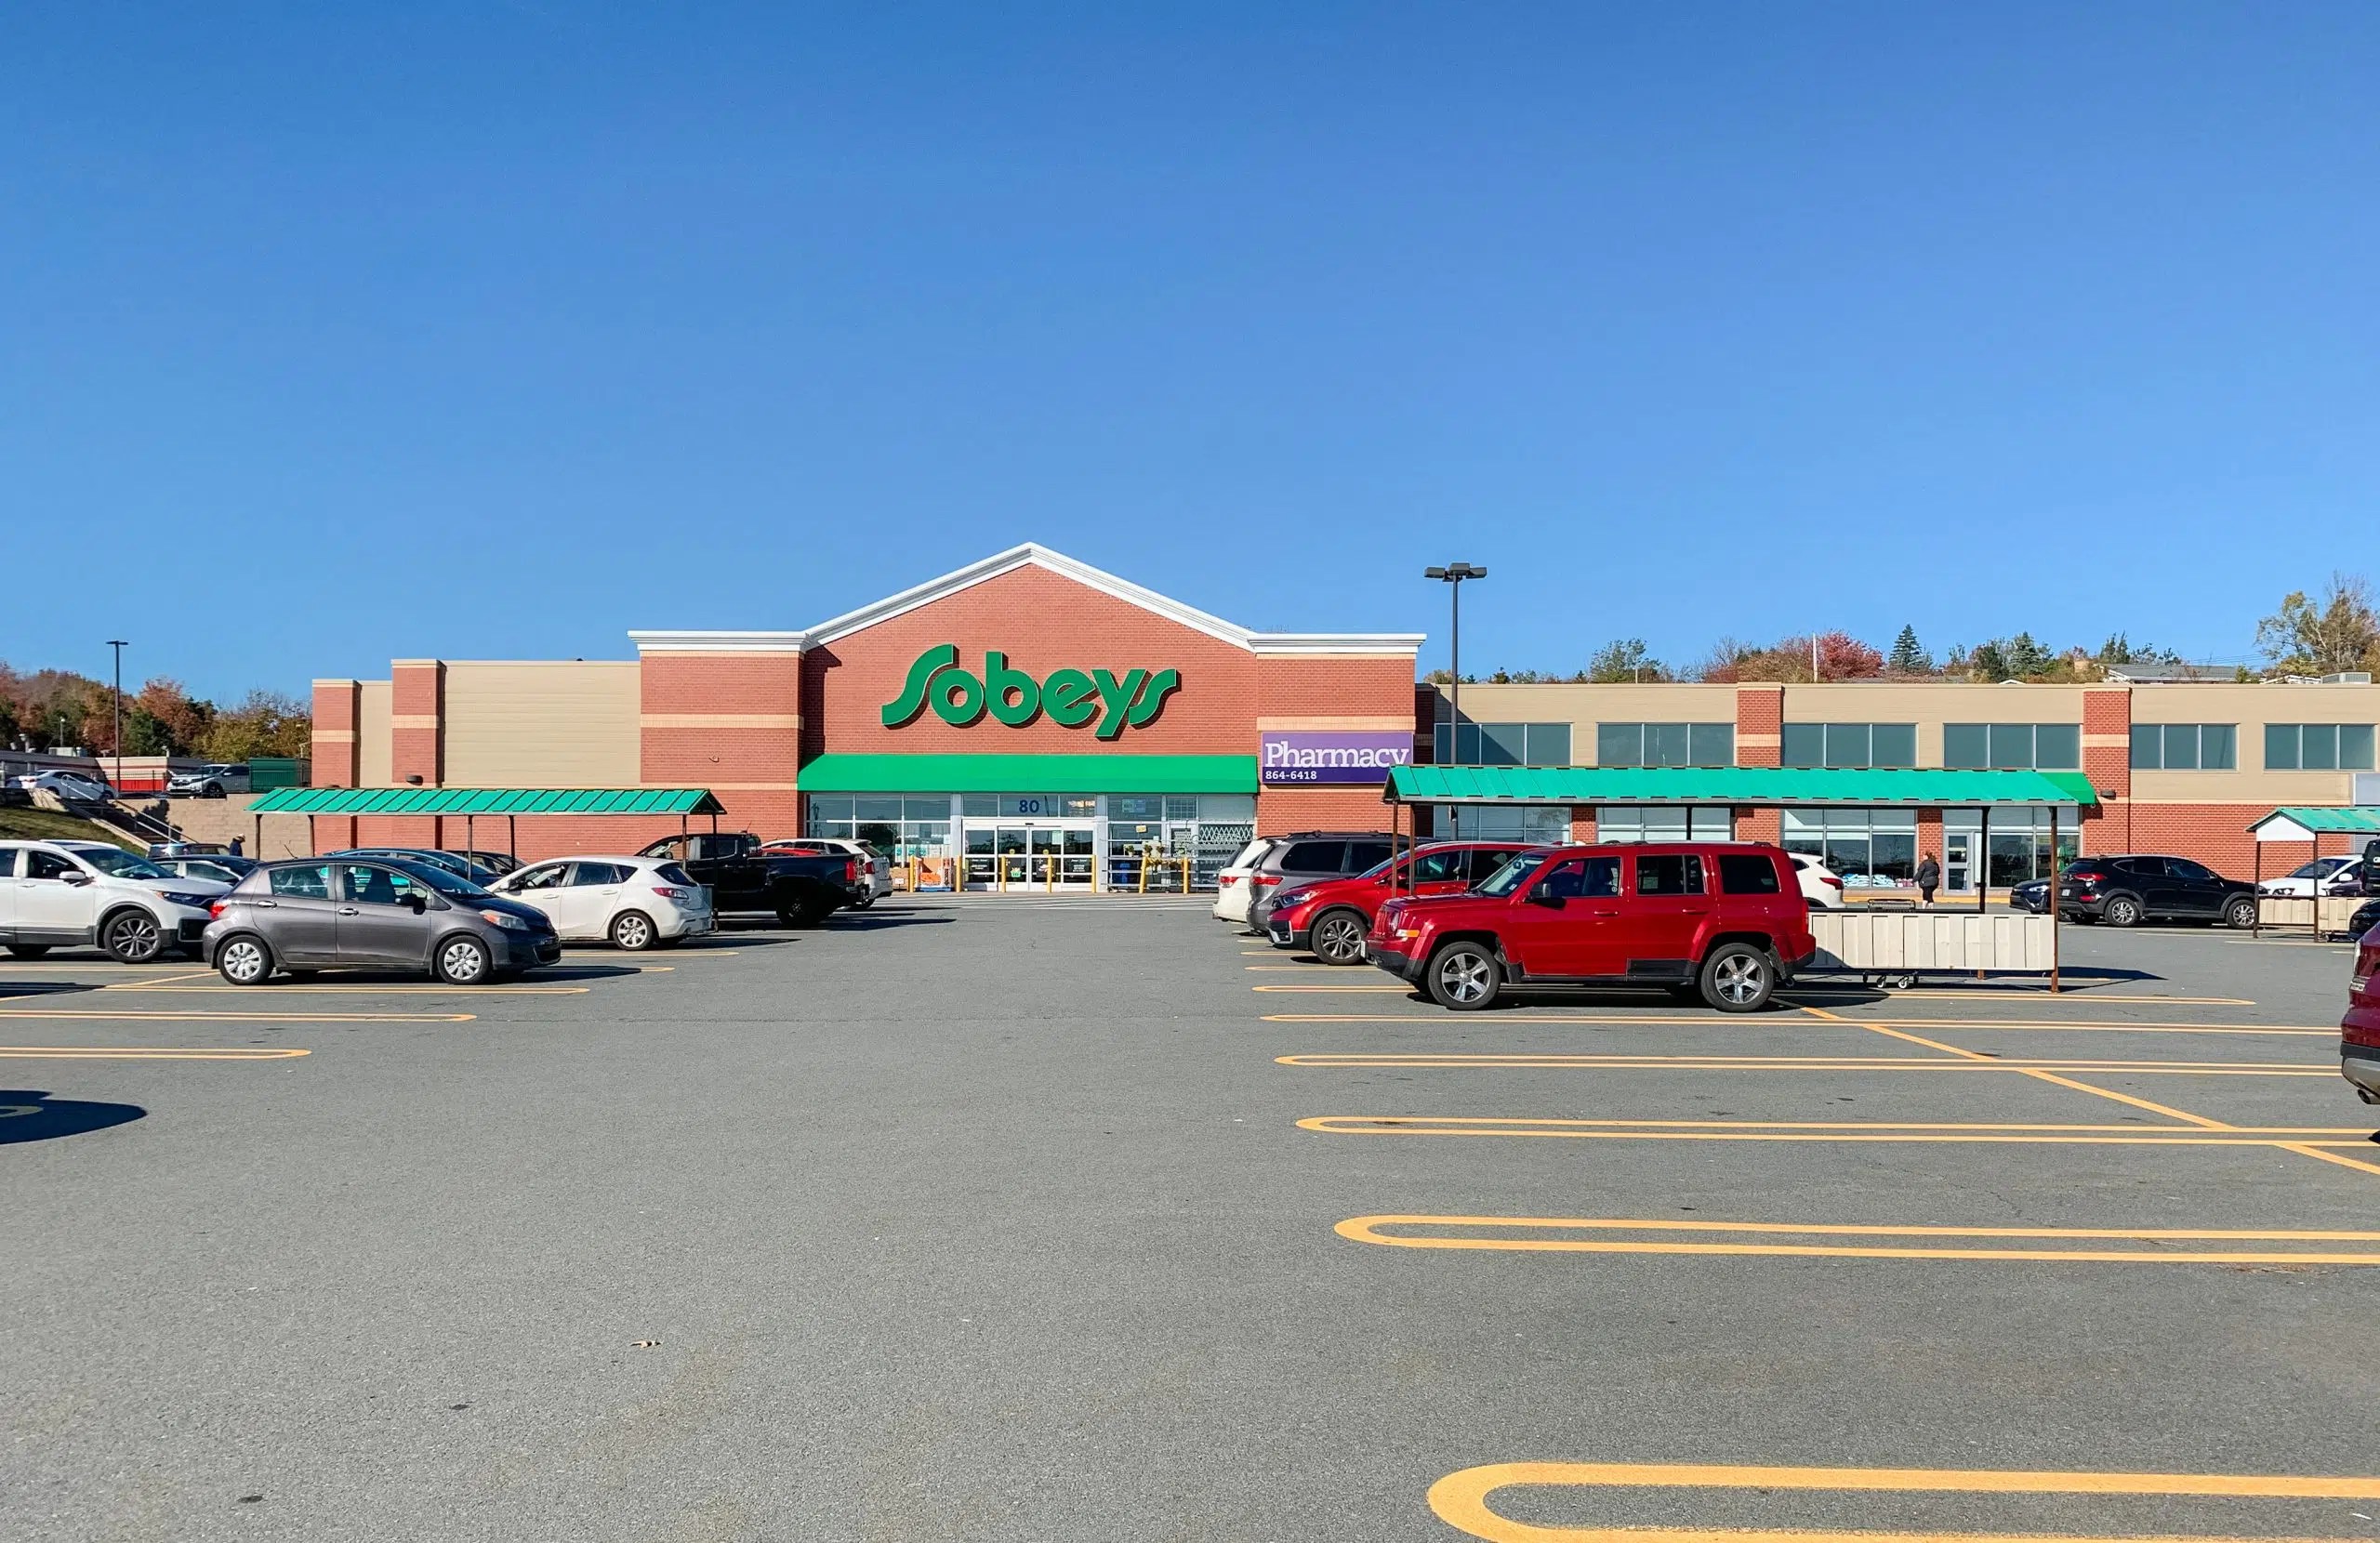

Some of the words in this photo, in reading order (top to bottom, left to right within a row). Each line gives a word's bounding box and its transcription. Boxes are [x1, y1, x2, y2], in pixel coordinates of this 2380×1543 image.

[881, 643, 1177, 737] Sobeys
[1264, 741, 1409, 768] Pharmacy
[1265, 771, 1317, 780] 864-6418
[1019, 799, 1039, 813] 80
